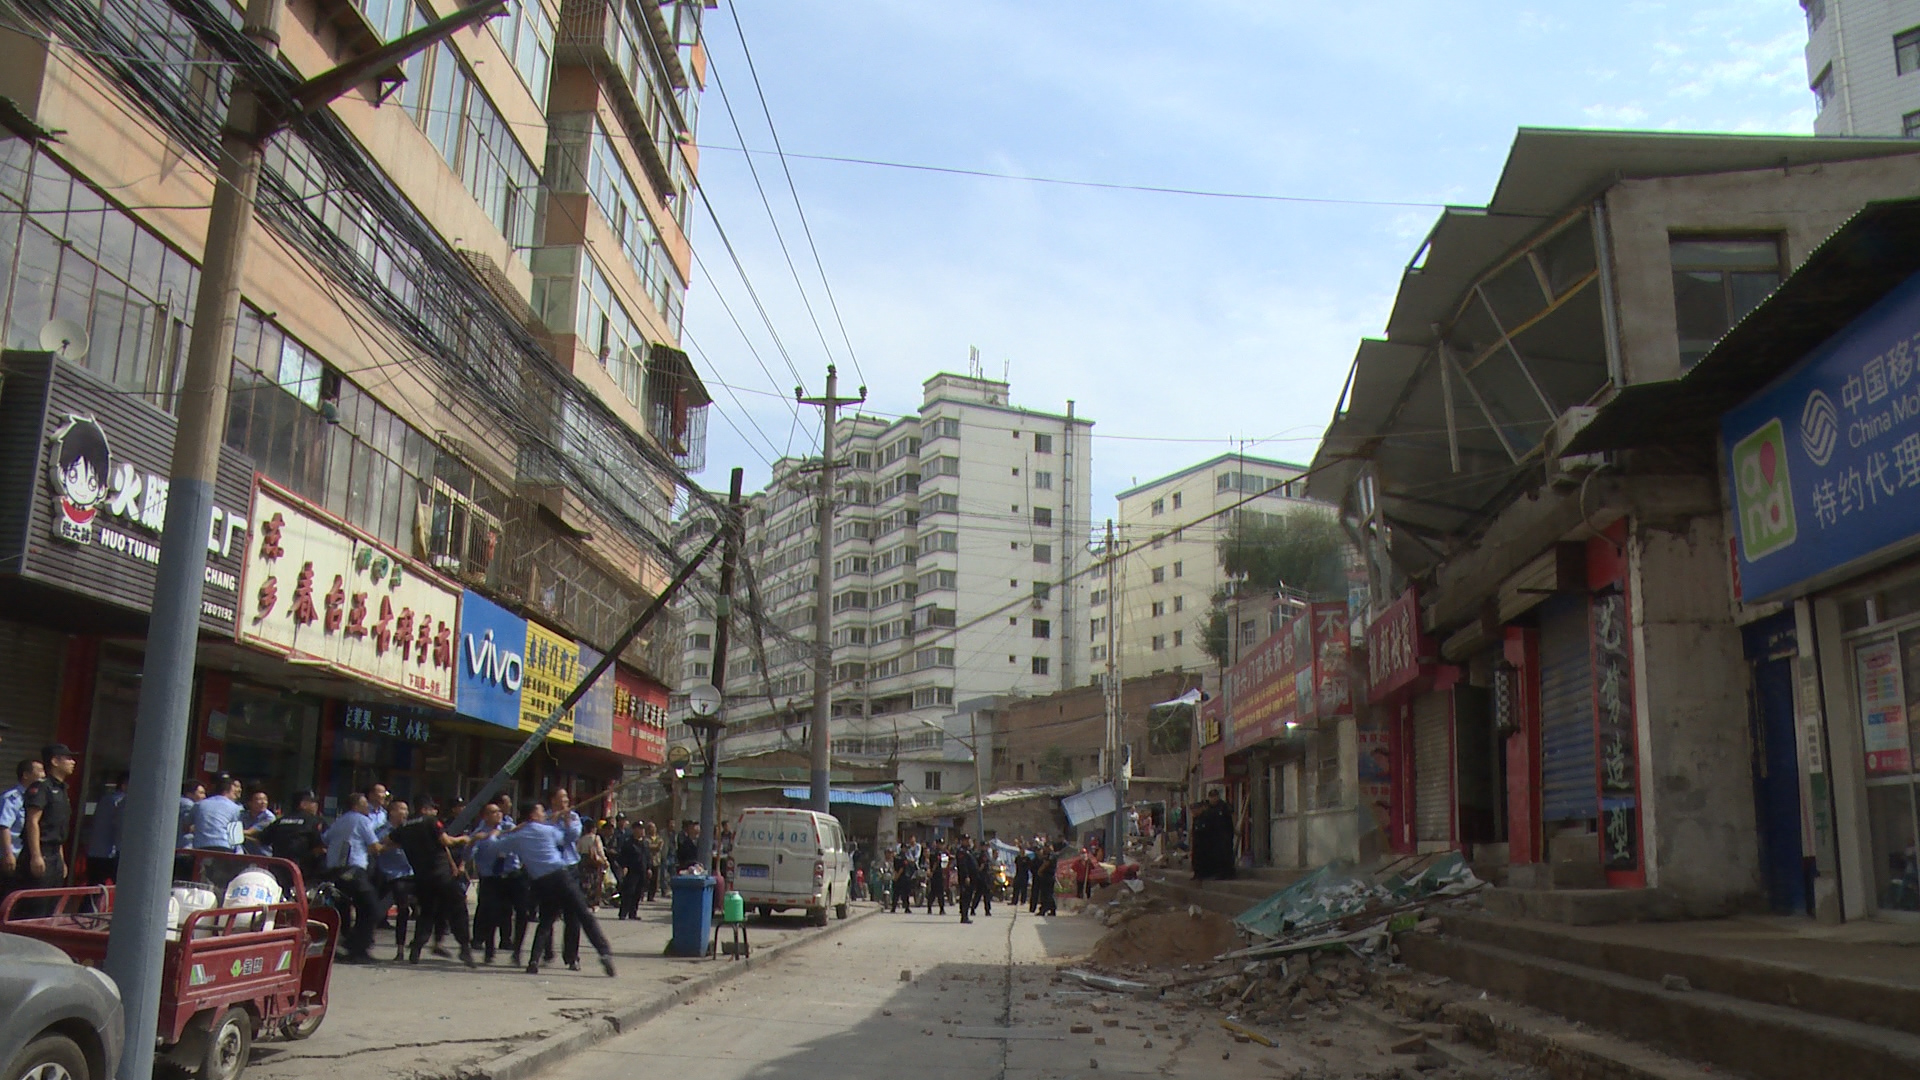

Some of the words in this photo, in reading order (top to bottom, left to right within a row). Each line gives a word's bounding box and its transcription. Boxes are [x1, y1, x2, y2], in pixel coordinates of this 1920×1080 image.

[1848, 410, 1891, 449] China
[1892, 391, 1920, 422] Mo
[101, 527, 126, 551] HUO
[126, 538, 147, 560] TUI
[205, 566, 236, 591] CHANG
[466, 629, 524, 693] vivo
